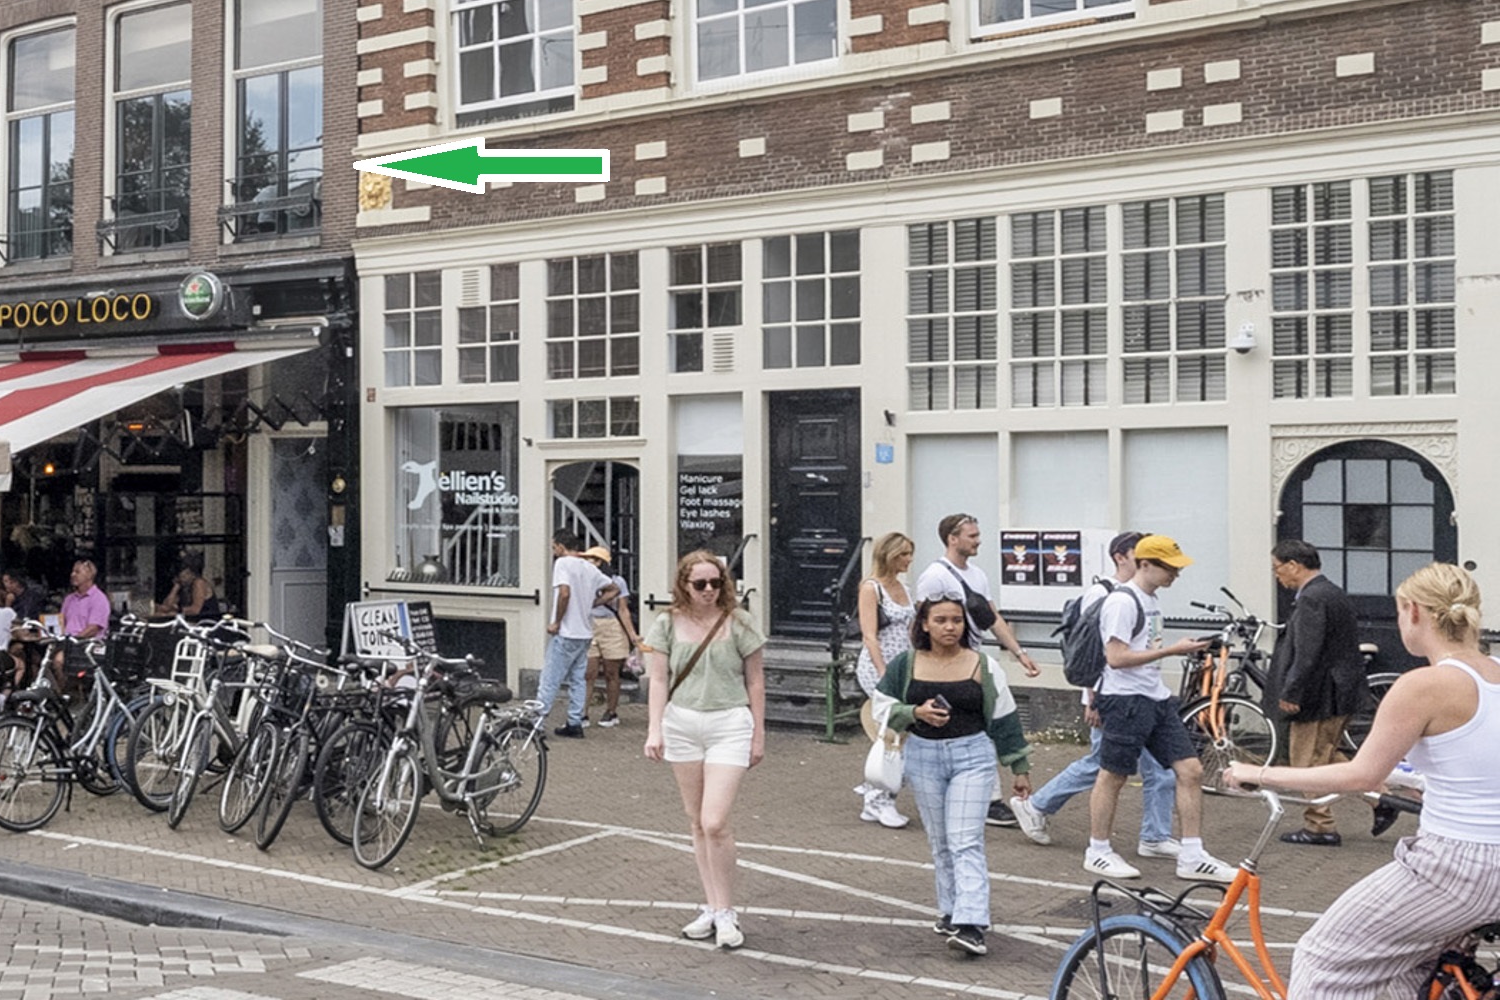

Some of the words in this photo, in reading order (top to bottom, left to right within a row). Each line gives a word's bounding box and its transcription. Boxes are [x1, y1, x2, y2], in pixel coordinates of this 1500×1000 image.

[77, 293, 151, 324] LOCO
[680, 474, 723, 483] Manicure
[680, 485, 697, 495] Gel
[698, 485, 718, 495] lack
[455, 491, 519, 506] Nailstudio
[680, 497, 701, 506] Foot
[680, 508, 698, 519] Eye
[700, 508, 731, 518] lashes
[680, 520, 715, 531] Waxing
[361, 606, 398, 627] CLEAN
